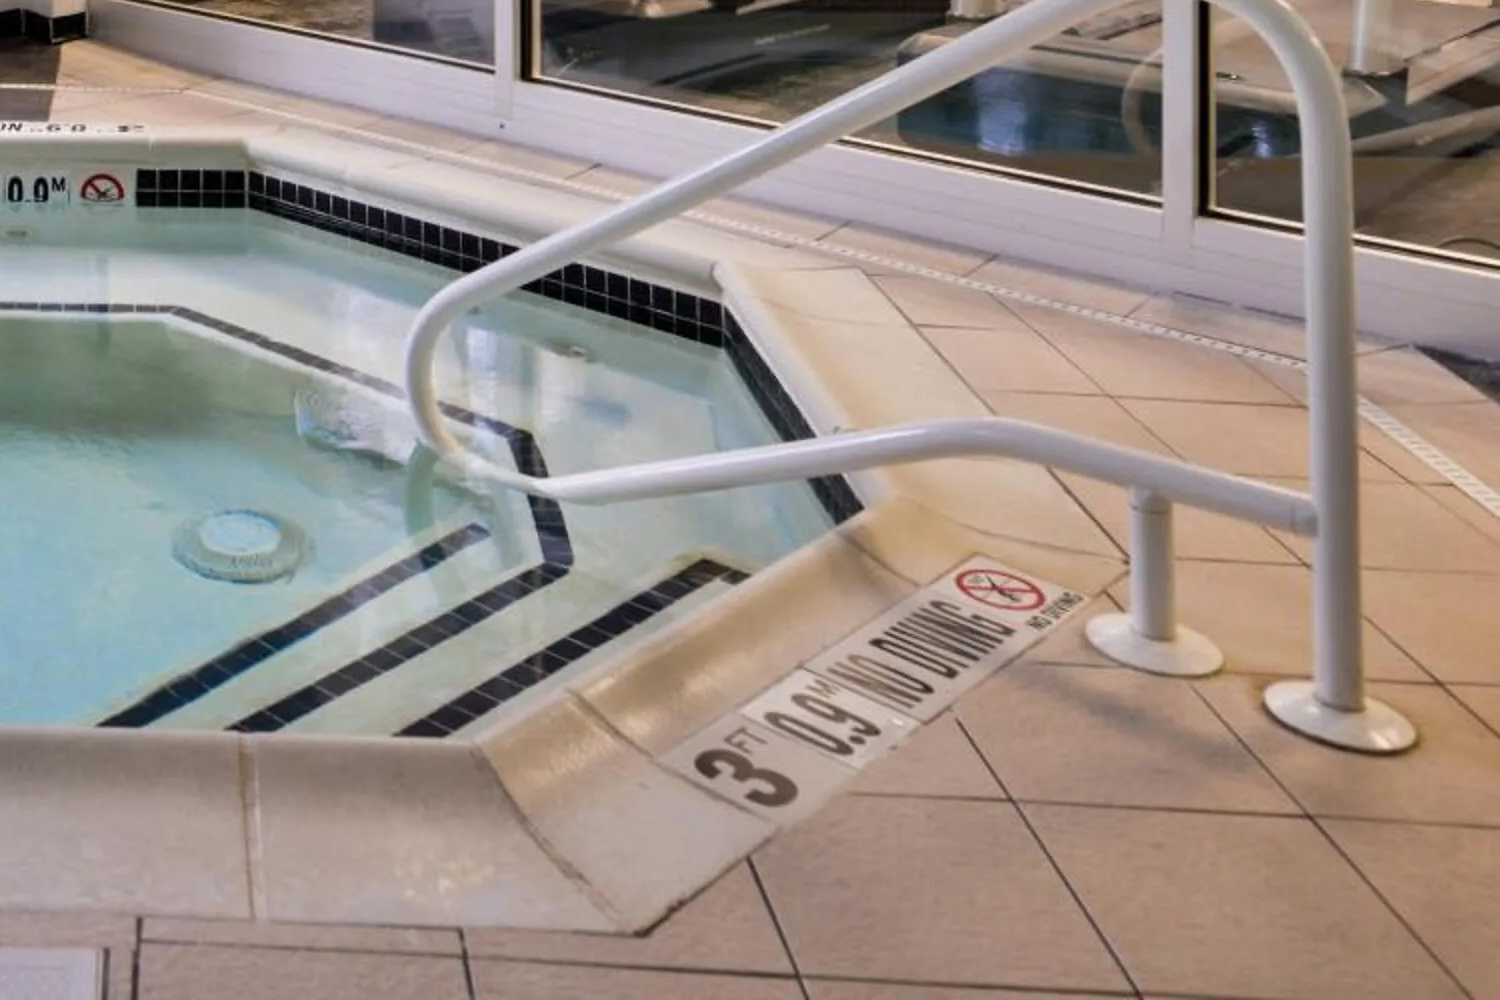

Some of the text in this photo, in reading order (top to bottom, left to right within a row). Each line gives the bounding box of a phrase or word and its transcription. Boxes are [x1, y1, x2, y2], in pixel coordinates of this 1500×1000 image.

[867, 600, 1017, 680] DIVING
[827, 654, 935, 709] NO
[723, 726, 769, 755] FT
[763, 692, 882, 757] 0.9
[693, 748, 799, 808] 3
